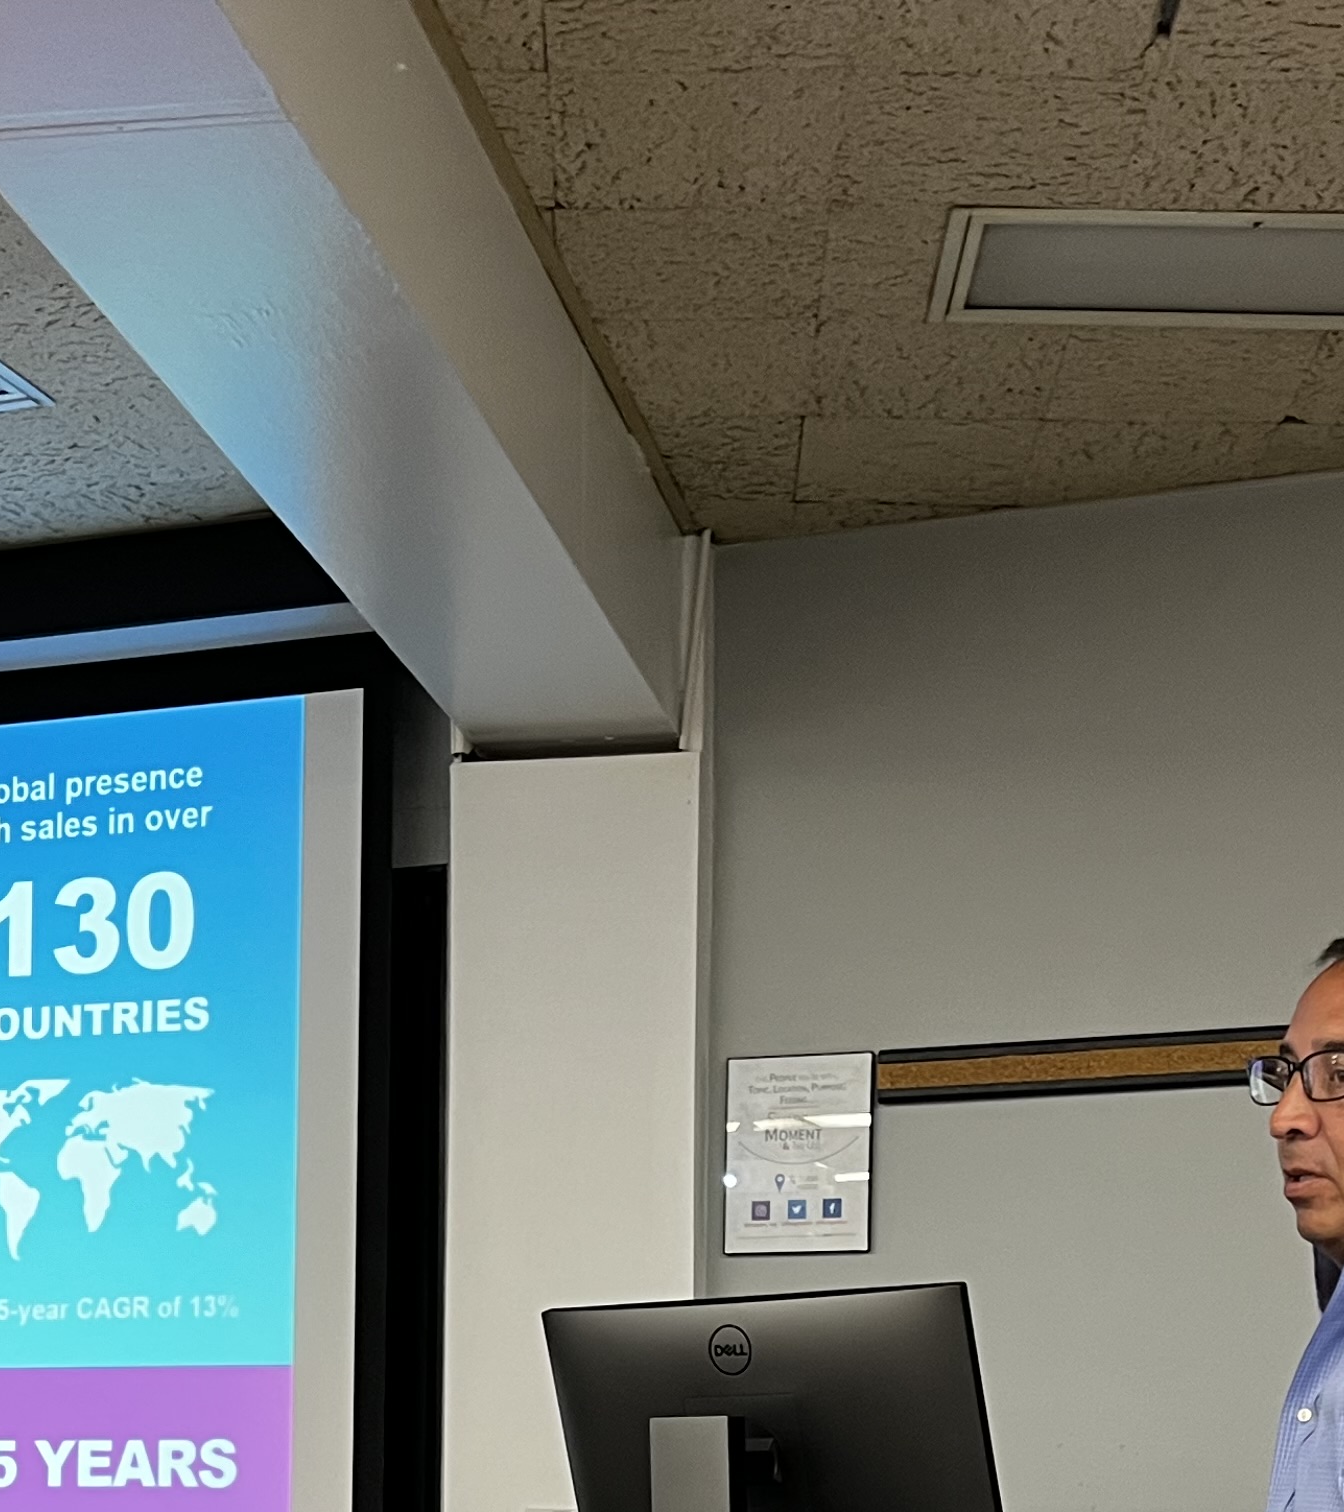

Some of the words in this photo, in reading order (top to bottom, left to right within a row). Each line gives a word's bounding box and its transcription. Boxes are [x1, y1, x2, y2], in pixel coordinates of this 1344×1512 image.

[64, 766, 204, 805] presence
[20, 811, 98, 842] sales
[108, 806, 136, 835] in
[145, 804, 213, 831] over
[764, 1128, 822, 1142] MOMENT
[76, 1297, 150, 1320] CAGR
[157, 1295, 182, 1319] of
[188, 1294, 240, 1319] 13%
[714, 1343, 748, 1357] DELL
[34, 1438, 238, 1489] YEARS
